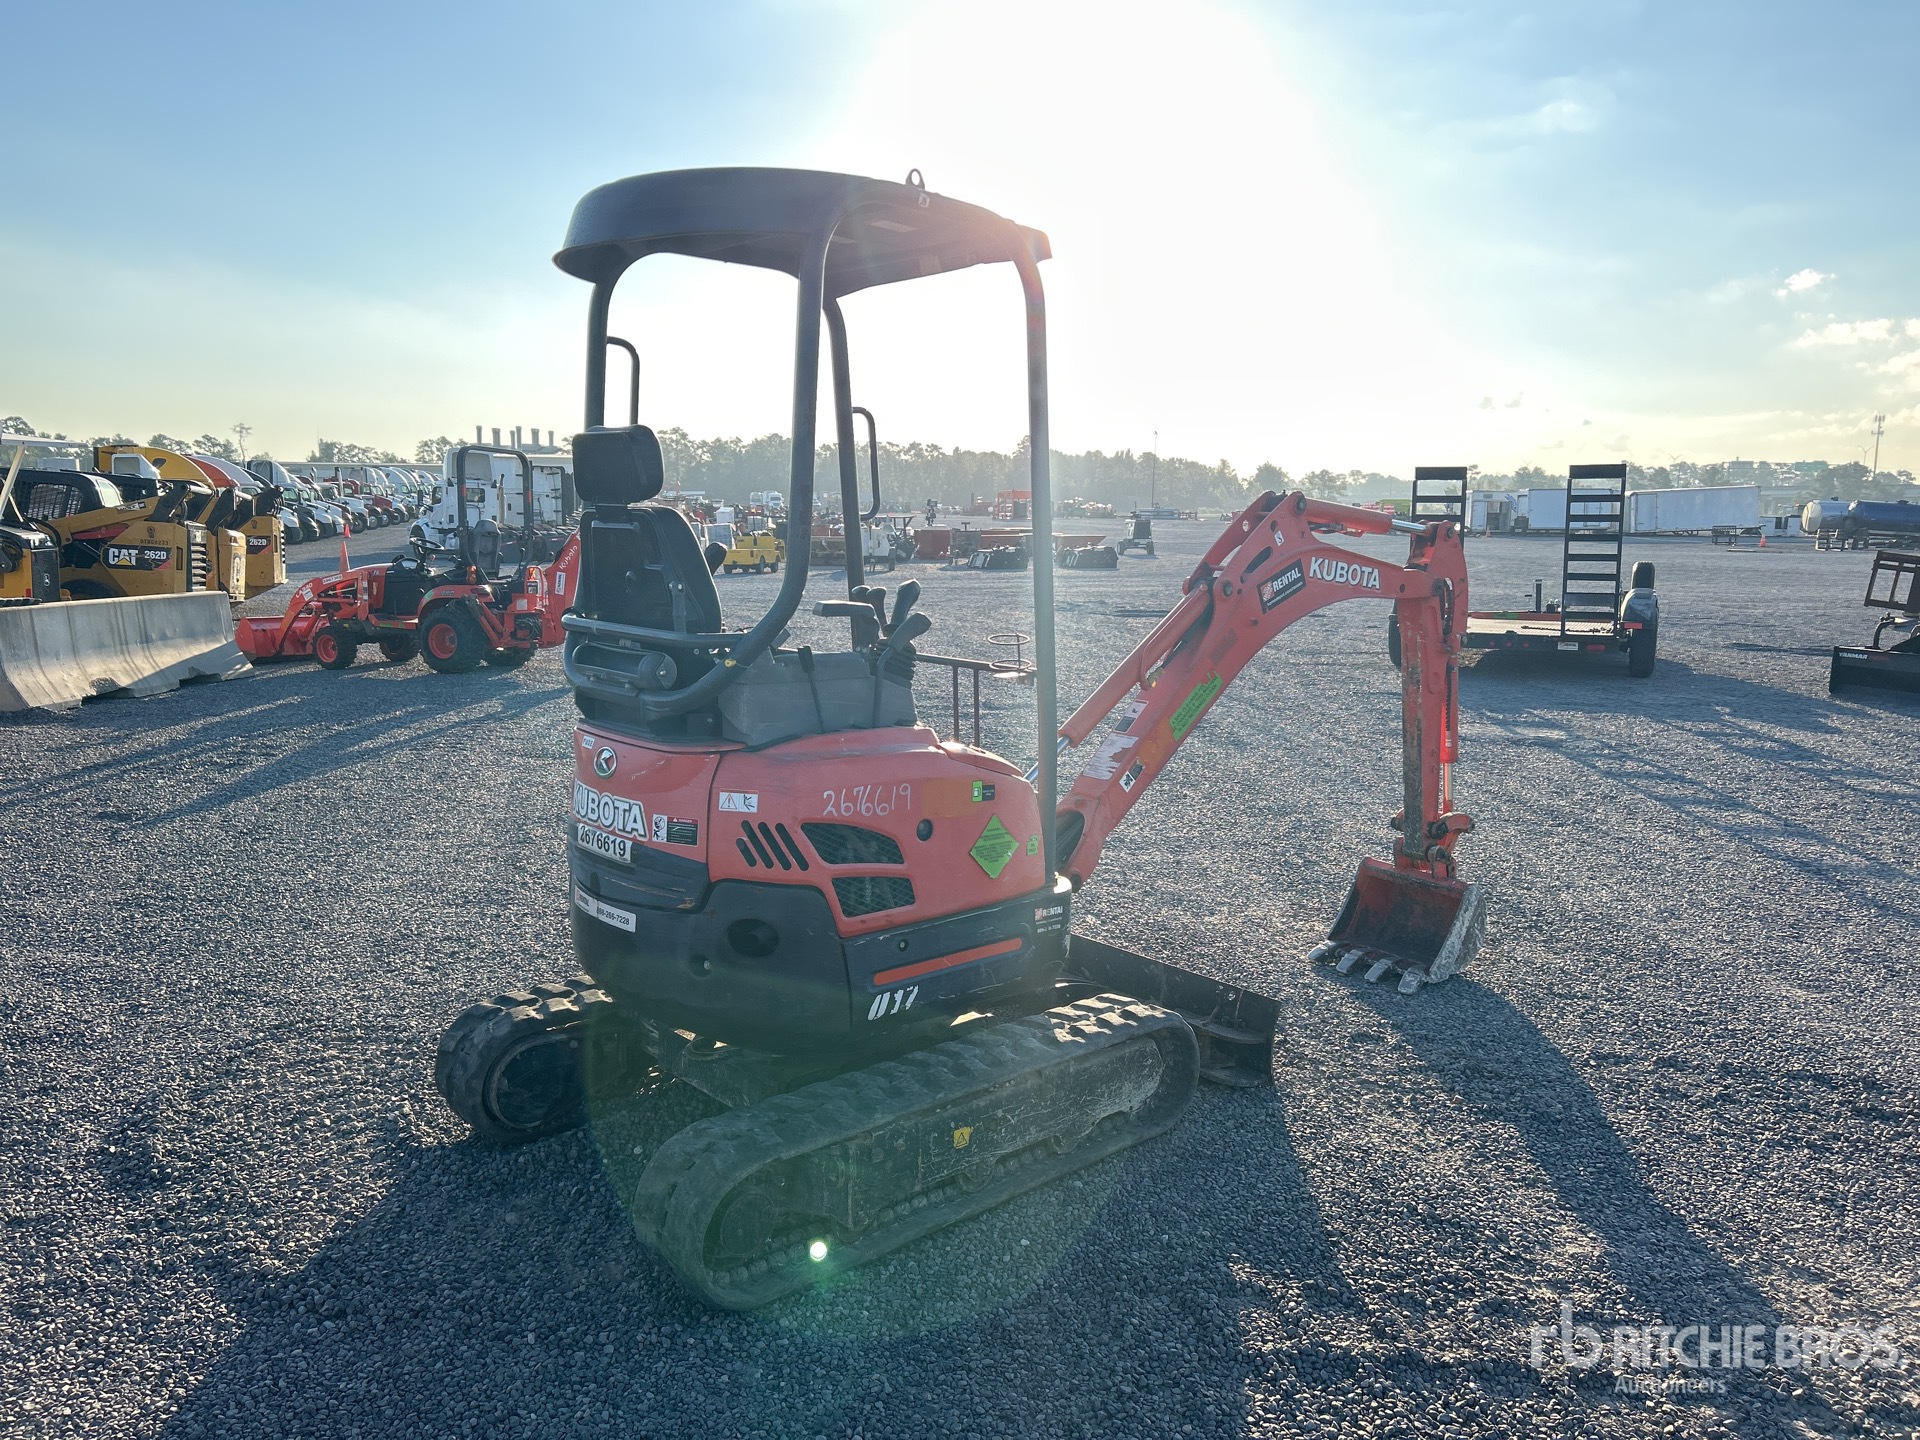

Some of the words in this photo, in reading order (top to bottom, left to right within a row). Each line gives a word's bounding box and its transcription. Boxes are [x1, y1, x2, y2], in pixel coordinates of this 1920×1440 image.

[144, 550, 167, 560] 262D
[249, 538, 267, 546] 262D
[108, 548, 139, 566] CAT
[1272, 567, 1302, 592] RENTAL
[1308, 556, 1380, 590] KUBOTA
[1839, 652, 1868, 660] YANMAR
[574, 782, 648, 839] KUBOTA
[823, 783, 911, 817] 2676619
[579, 825, 627, 858] 2676619
[867, 984, 919, 1021] 017
